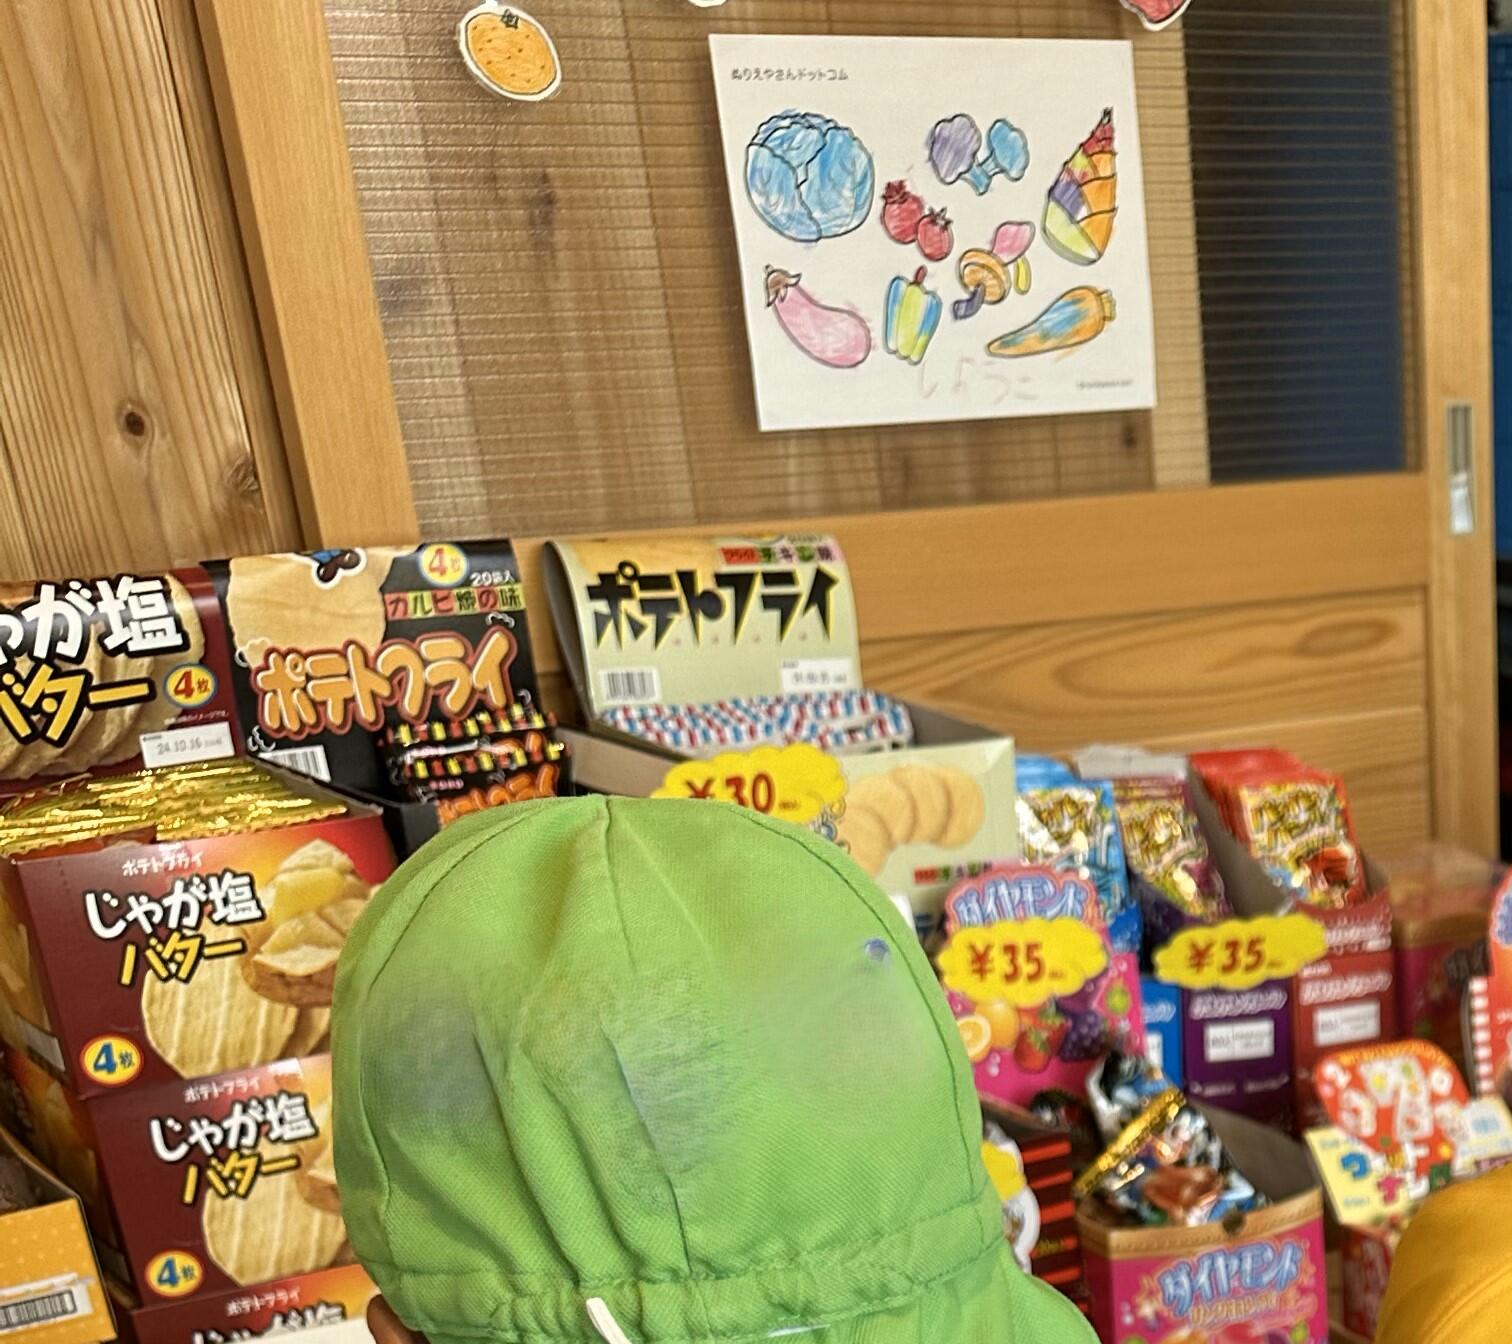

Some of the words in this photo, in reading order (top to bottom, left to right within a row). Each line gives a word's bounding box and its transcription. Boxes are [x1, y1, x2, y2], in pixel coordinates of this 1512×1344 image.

[388, 588, 522, 618] カルビ焼の味
[586, 559, 839, 651] ポテトフライ
[255, 630, 511, 732] ポテトフライ
[85, 870, 263, 939] じゃが塩
[119, 931, 246, 986] バター
[968, 942, 1047, 984] ¥35
[1187, 938, 1265, 976] ¥35
[149, 1090, 318, 1162] じゃが塩
[182, 1150, 299, 1205] バター
[1158, 1241, 1302, 1319] ダイヤモンド
